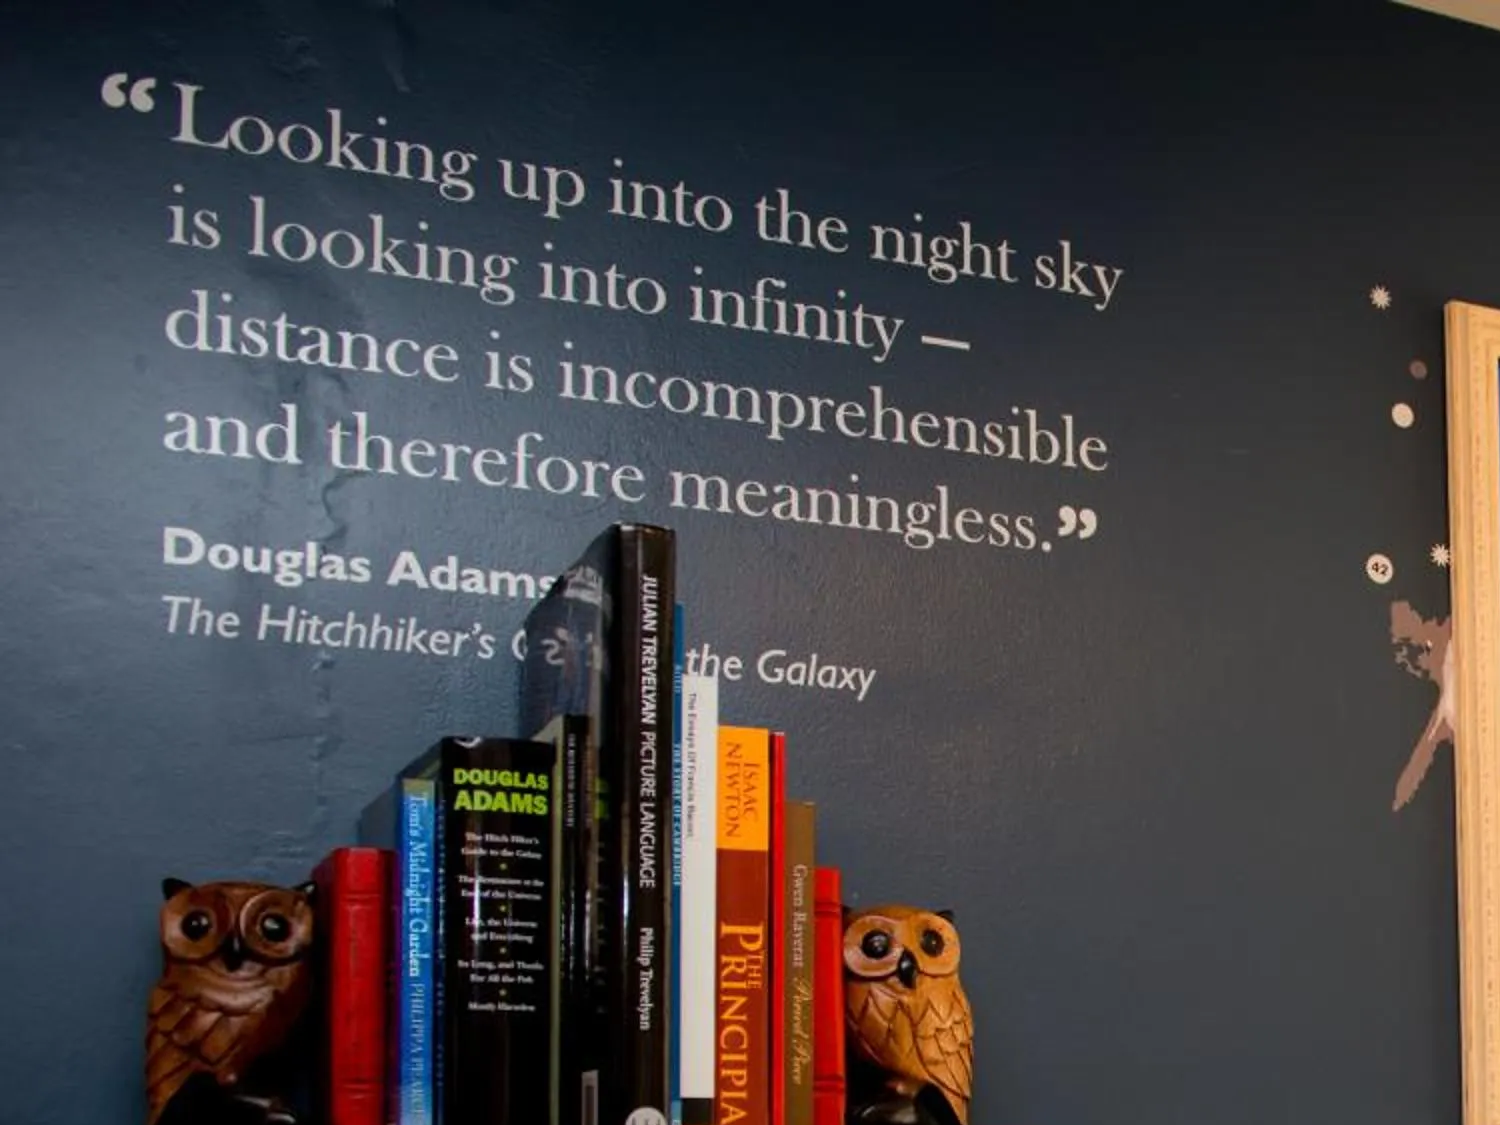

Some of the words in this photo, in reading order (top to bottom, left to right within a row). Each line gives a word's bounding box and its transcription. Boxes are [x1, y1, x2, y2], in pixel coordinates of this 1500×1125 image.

[500, 160, 587, 219] up
[609, 159, 734, 233] into
[757, 189, 850, 254] the
[873, 215, 1019, 285] night
[1036, 241, 1124, 312] sky
[169, 185, 222, 250] is
[249, 196, 520, 306] looking
[541, 243, 668, 315] into
[691, 268, 906, 363] infinity
[166, 291, 460, 383] distance
[487, 332, 535, 394] is
[561, 341, 1109, 473] incomprehensible
[165, 404, 302, 466] and
[329, 412, 647, 504] therefore
[163, 527, 372, 588] Douglas
[387, 551, 557, 600] Adams
[1371, 562, 1389, 576] 42
[163, 596, 241, 639] The
[258, 604, 496, 661] Hitchhiker’s
[641, 574, 658, 631] JULIAN
[640, 634, 658, 724] TREVELYAN
[685, 642, 744, 682] the
[757, 650, 878, 703] Galaxy
[453, 767, 549, 790] DOUGLAS
[639, 730, 657, 797] PICTURE
[725, 741, 743, 838] NEWTON
[743, 762, 761, 823] ISAAC
[409, 792, 427, 838] Tom's
[453, 789, 548, 815] ADAMS
[639, 801, 657, 889] LANGUAGE
[406, 841, 431, 914] Midnight
[409, 918, 430, 977] Garden
[635, 926, 655, 967] Philip
[744, 953, 763, 989] THE
[636, 968, 655, 1031] Trevelyan
